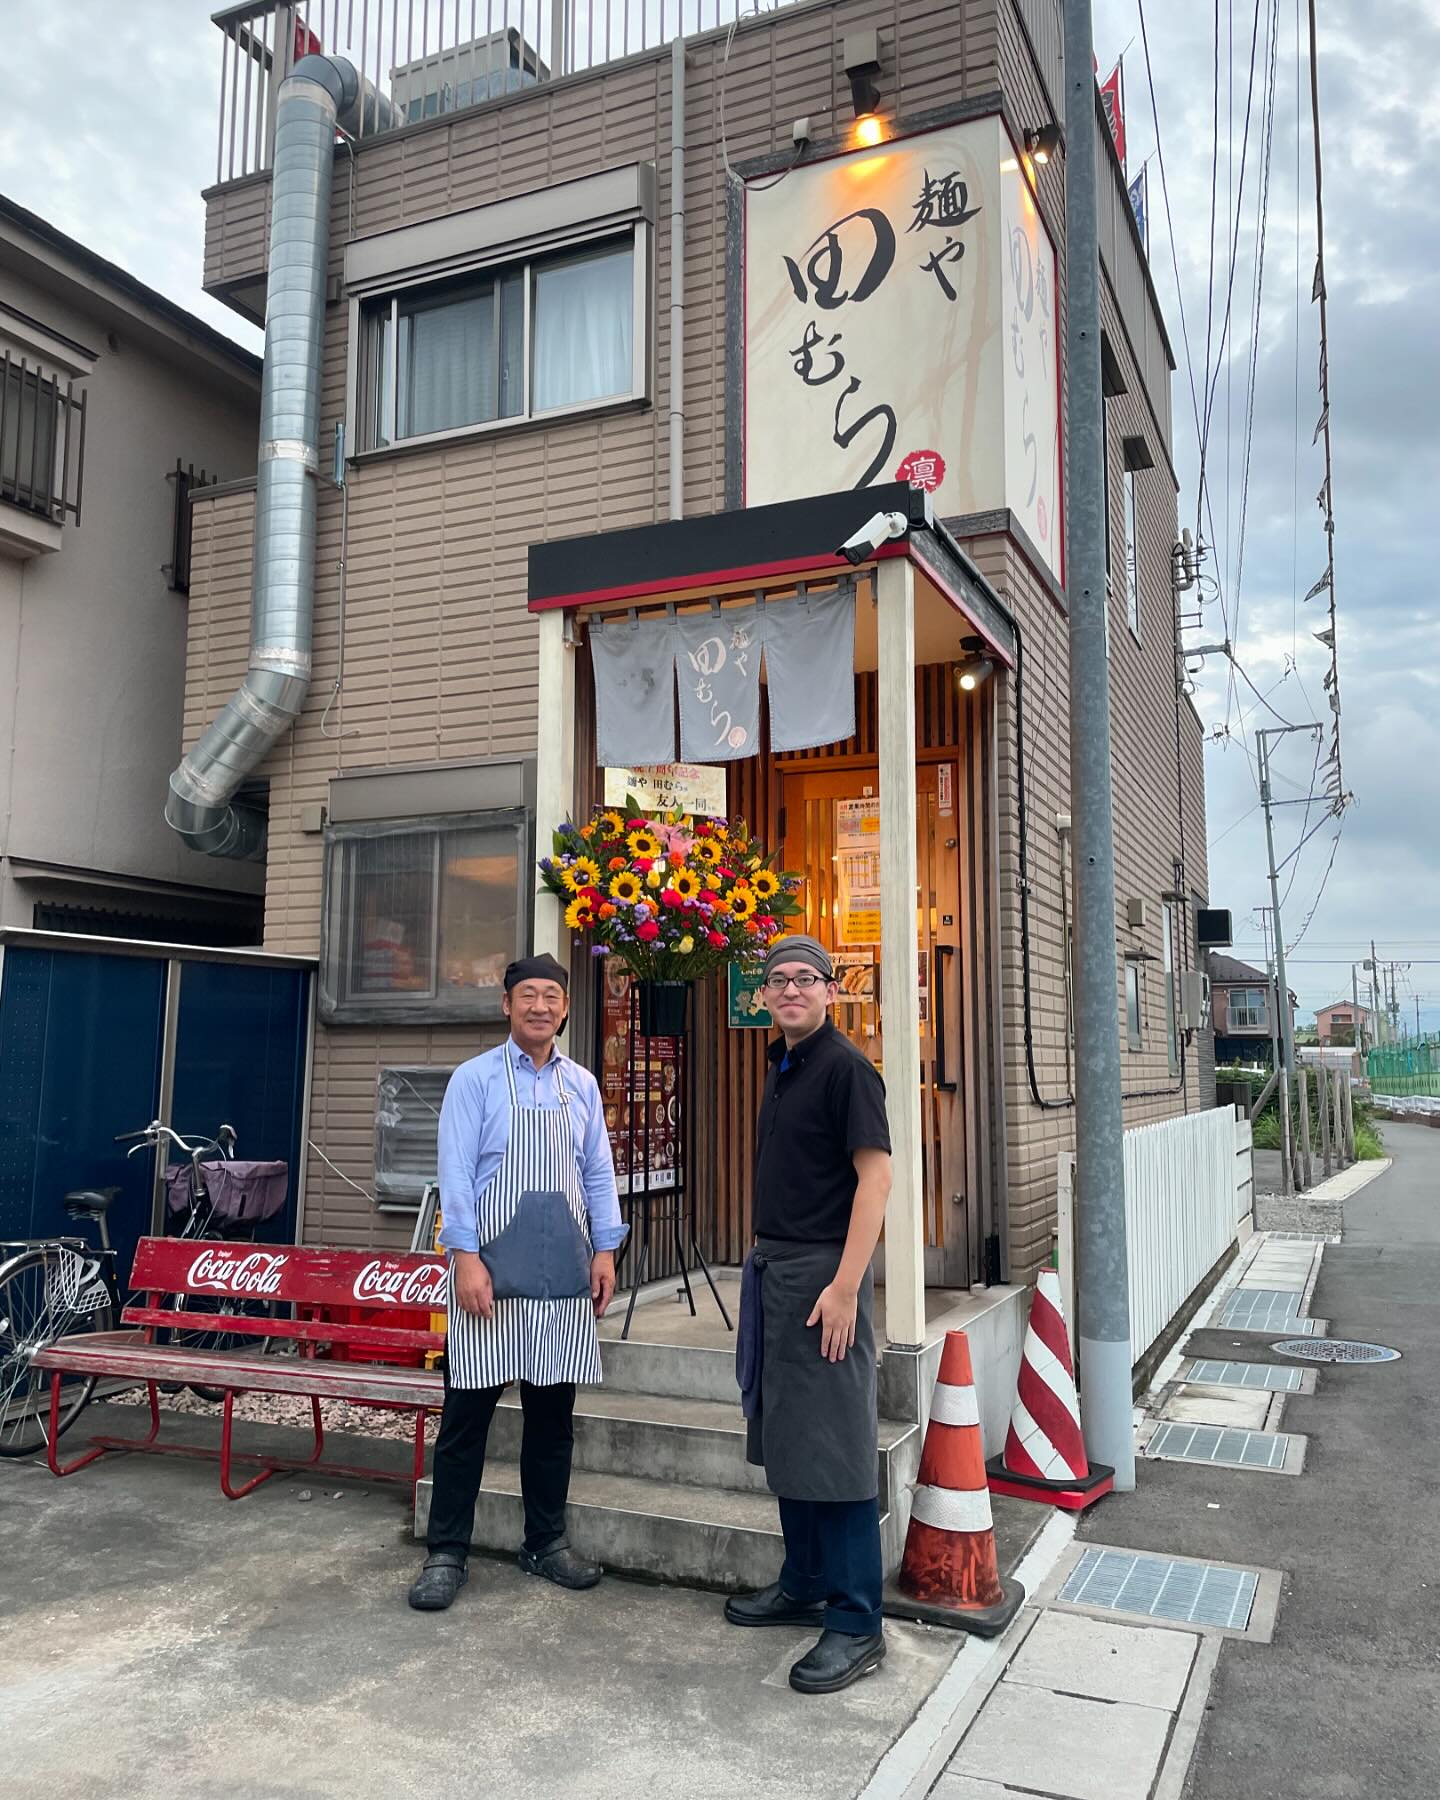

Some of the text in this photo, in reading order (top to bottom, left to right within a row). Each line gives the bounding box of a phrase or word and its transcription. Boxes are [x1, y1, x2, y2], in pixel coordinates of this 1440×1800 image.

[782, 208, 897, 490] 田むら
[688, 637, 732, 746] 田むら
[187, 1249, 290, 1294] Coca-Cola
